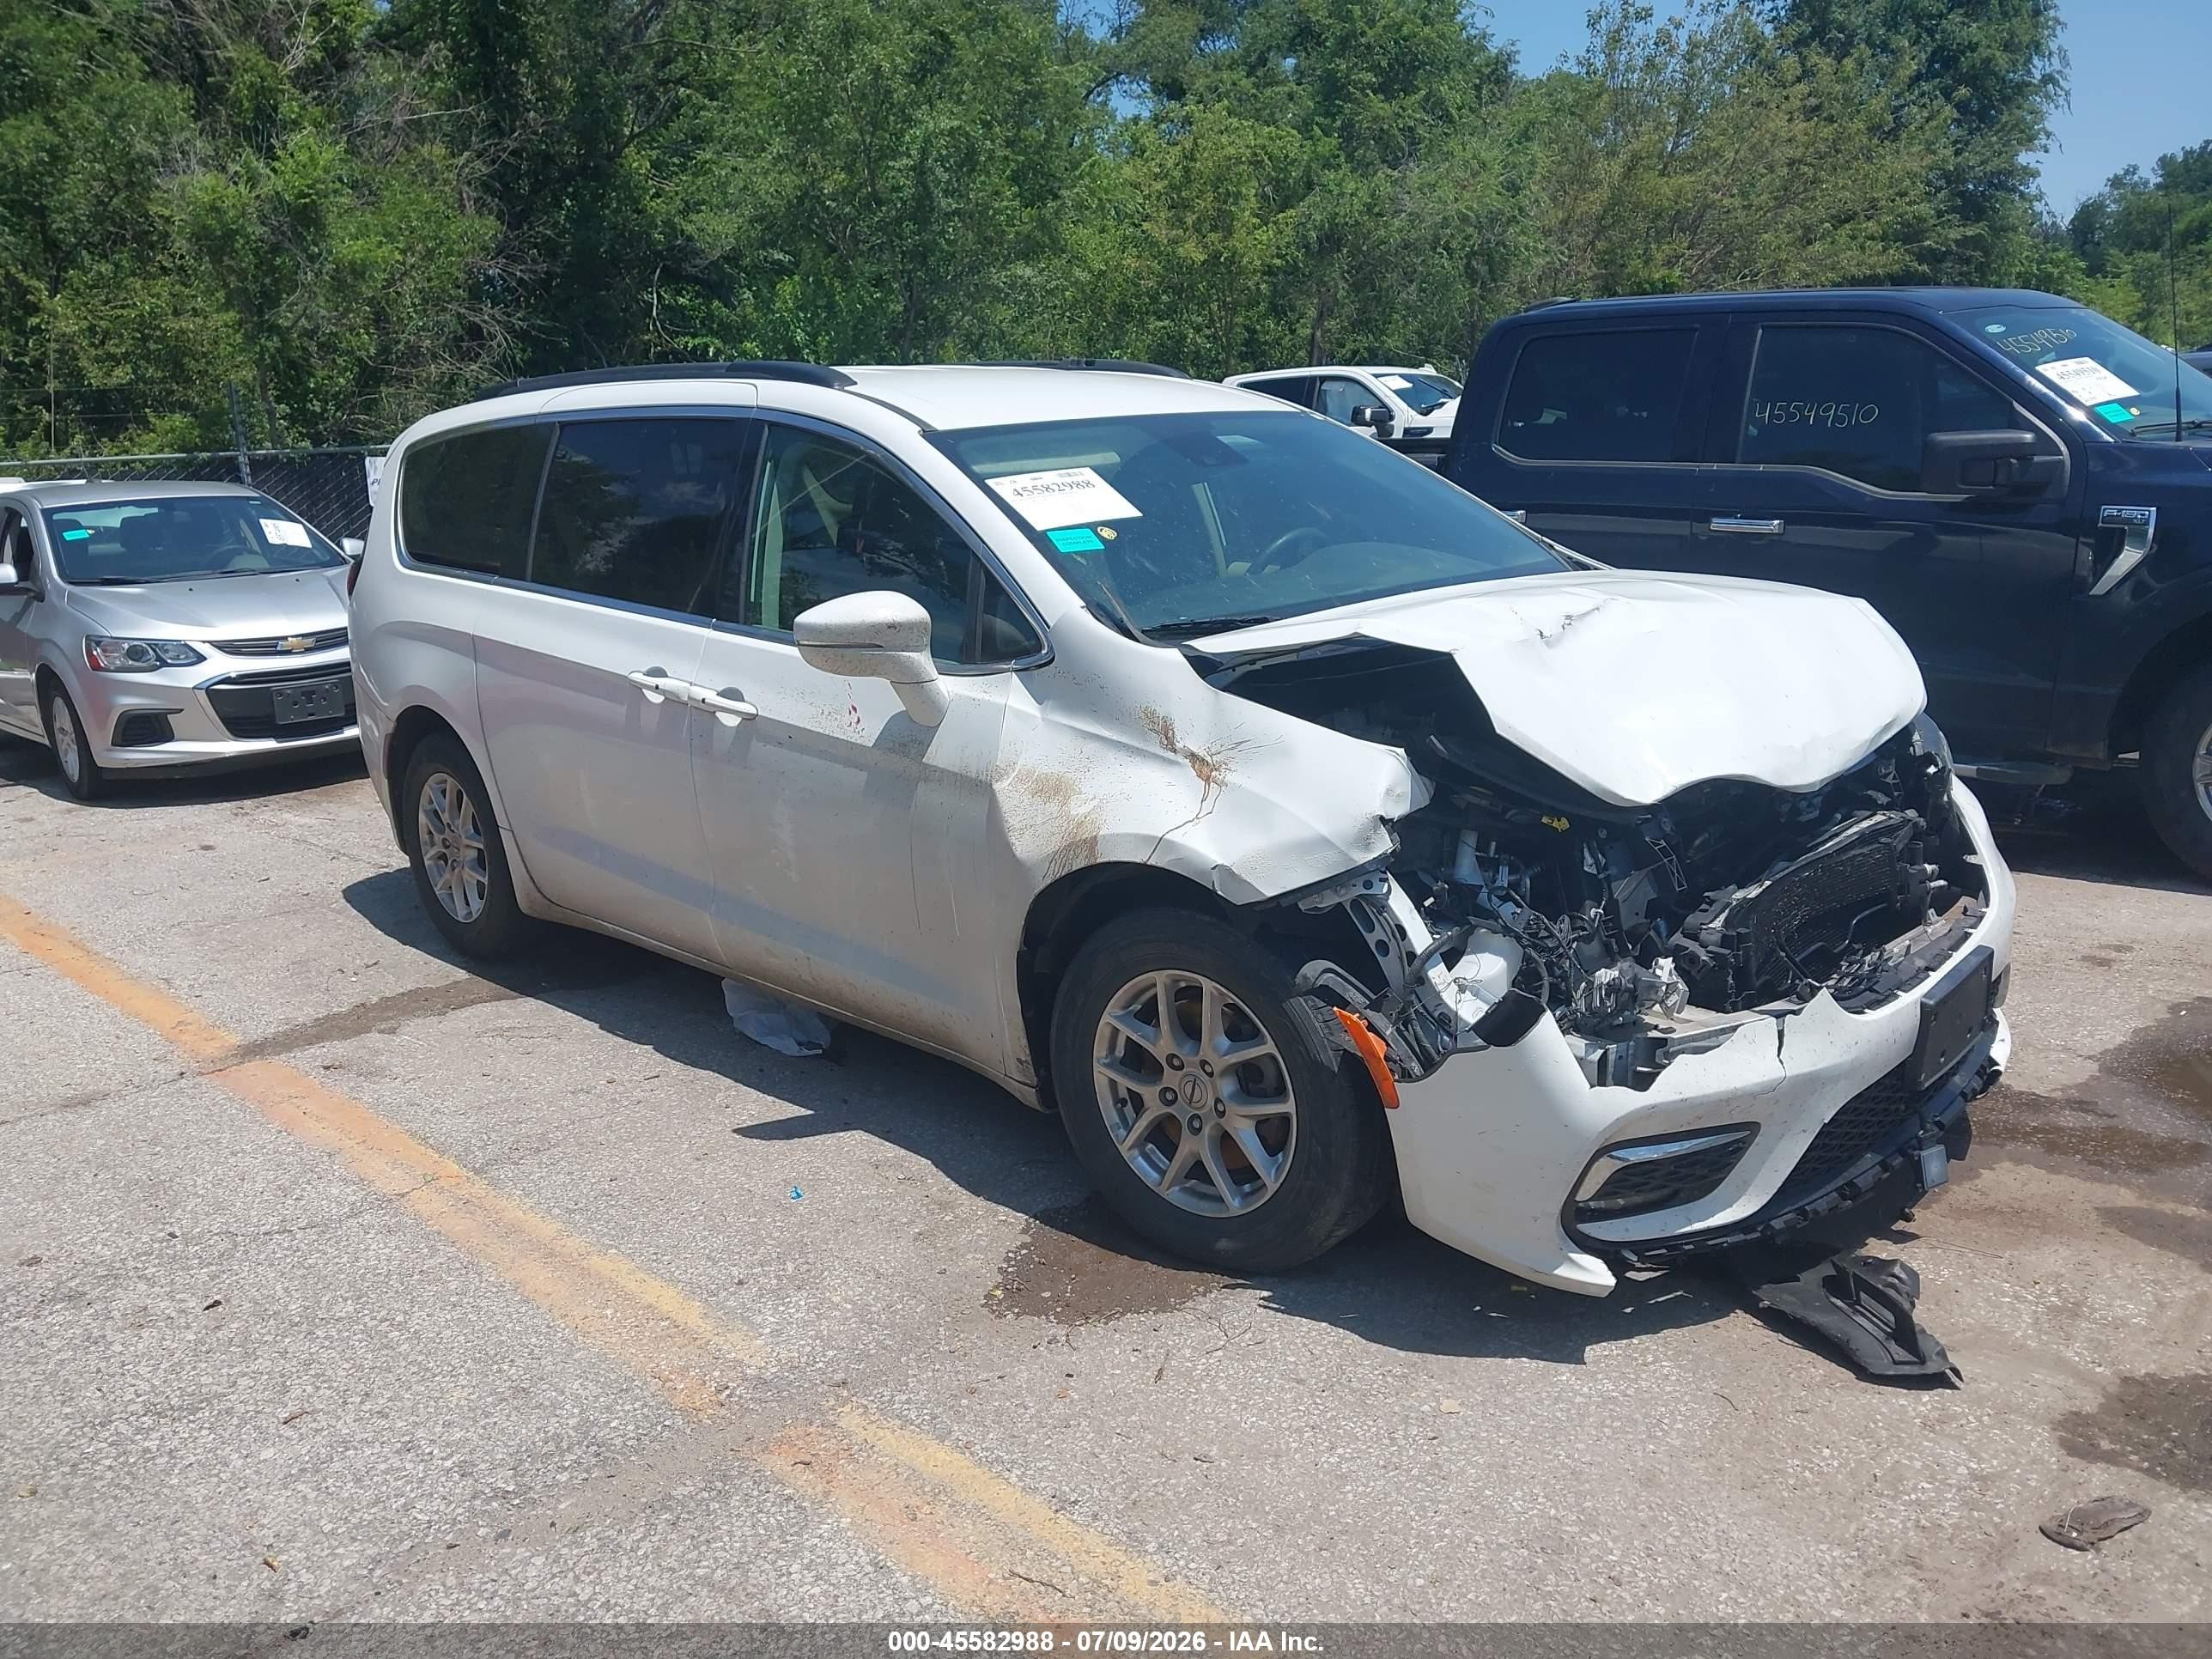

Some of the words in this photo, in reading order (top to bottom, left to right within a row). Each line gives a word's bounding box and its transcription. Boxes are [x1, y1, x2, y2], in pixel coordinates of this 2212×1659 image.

[1996, 328, 2077, 355] 45549510
[1755, 402, 1879, 428] 45549510
[1012, 479, 1096, 497] 45582988
[2103, 509, 2149, 519] F-150
